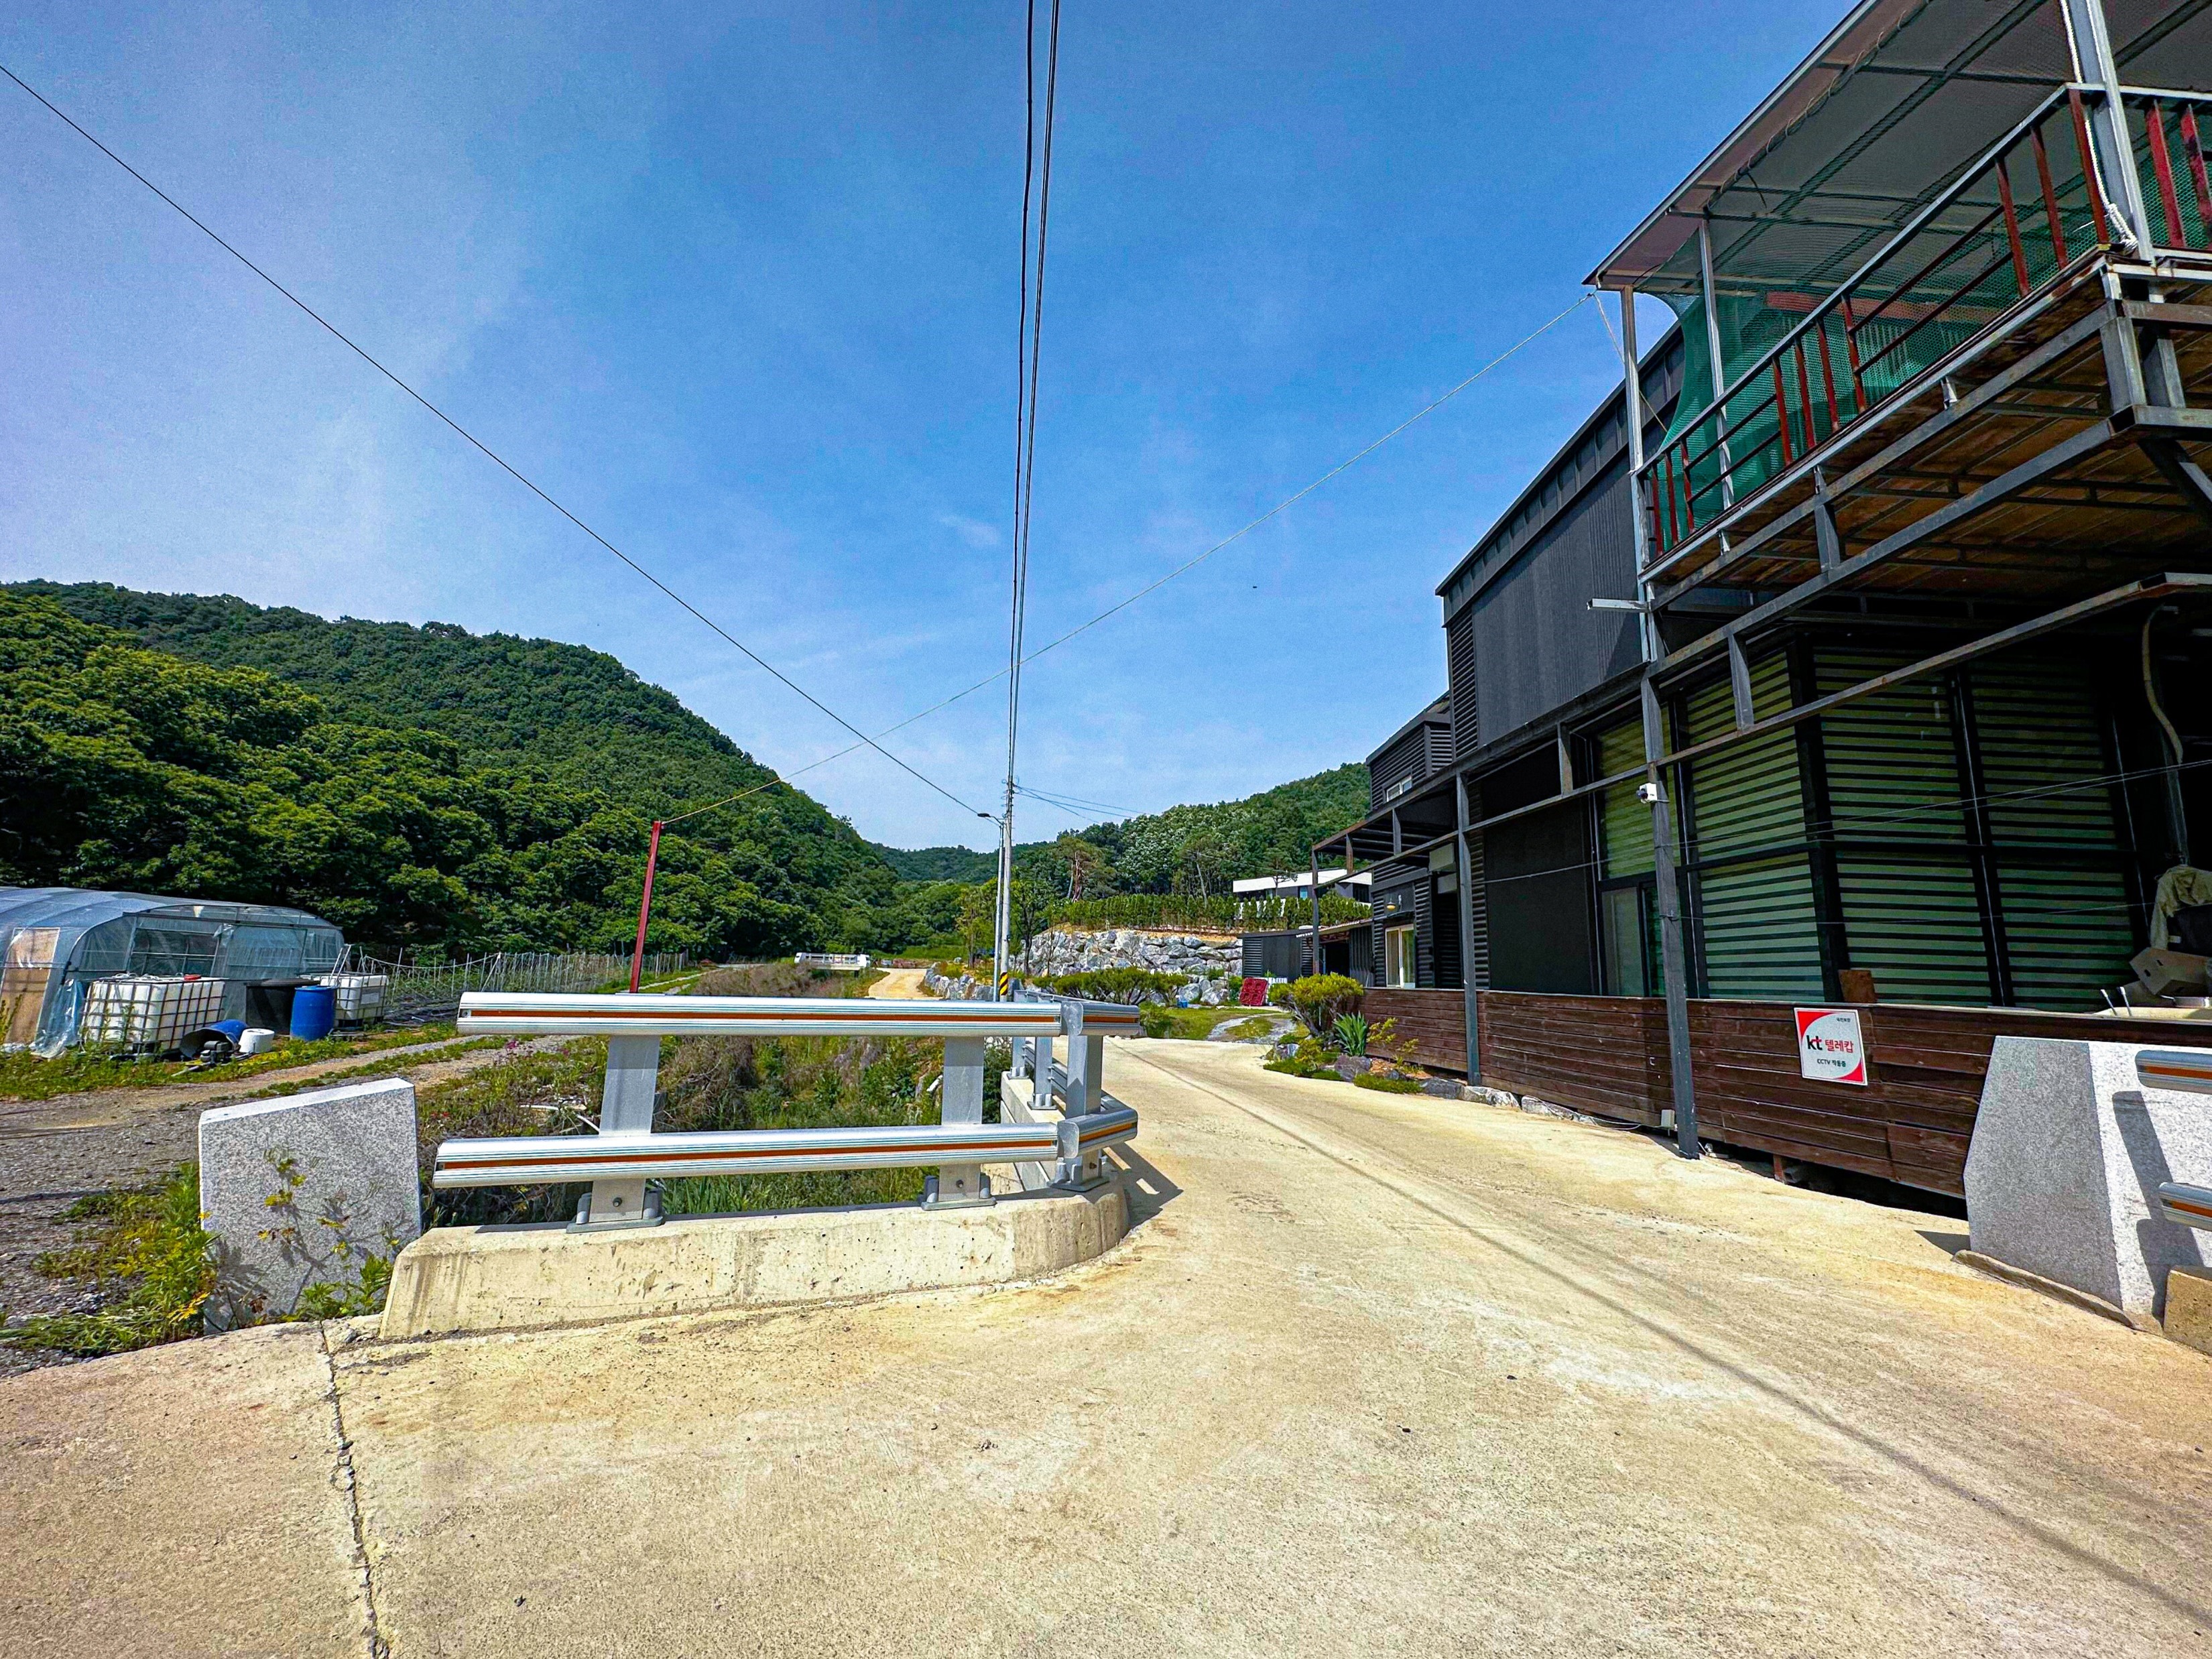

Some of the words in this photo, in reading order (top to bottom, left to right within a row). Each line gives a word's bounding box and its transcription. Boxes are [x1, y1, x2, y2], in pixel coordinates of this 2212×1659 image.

[1806, 1035, 1823, 1051] kt
[1825, 1039, 1853, 1054] 텔레캅
[1831, 1059, 1846, 1067] 작동중
